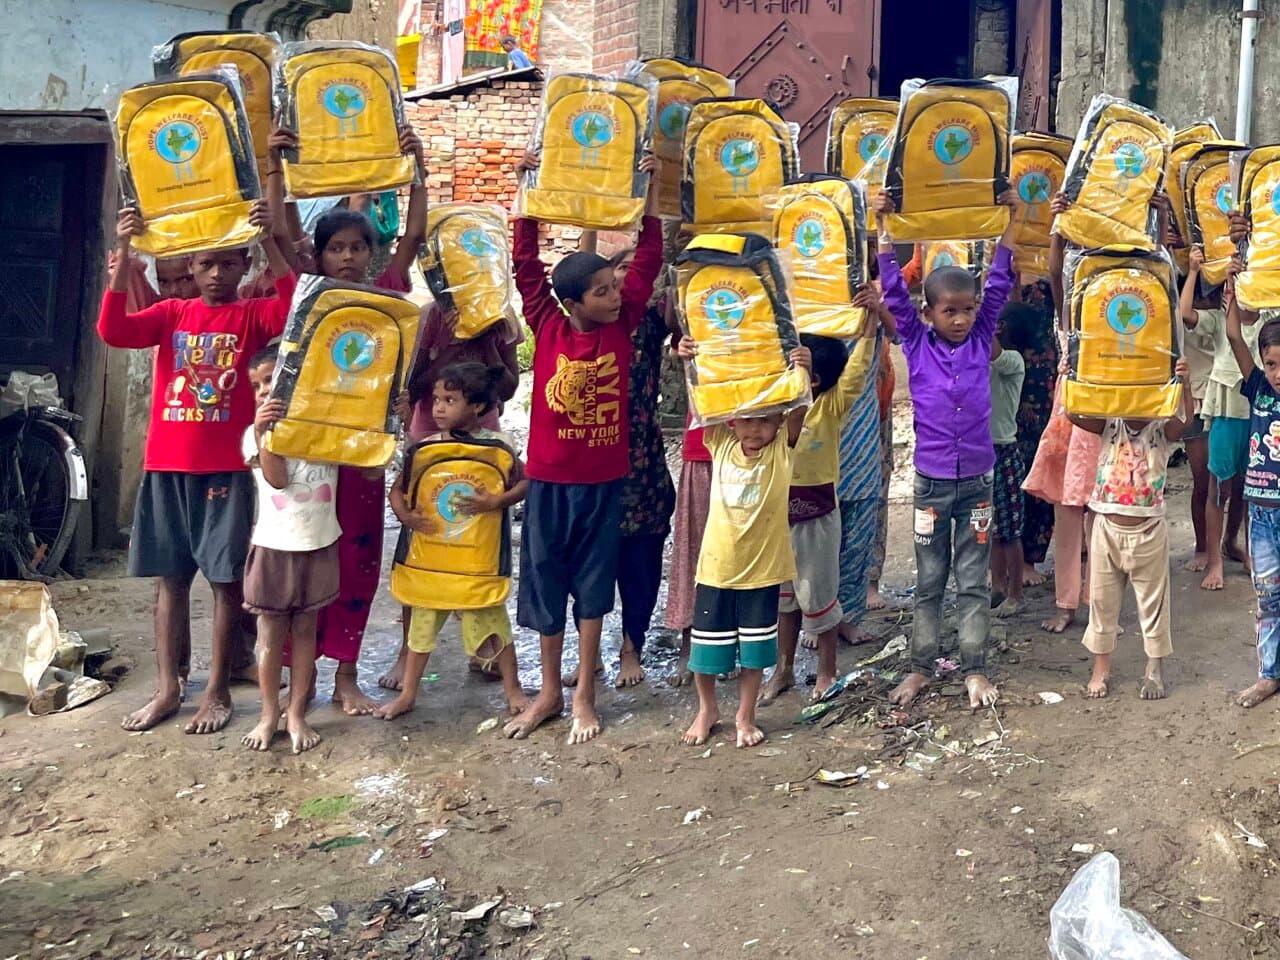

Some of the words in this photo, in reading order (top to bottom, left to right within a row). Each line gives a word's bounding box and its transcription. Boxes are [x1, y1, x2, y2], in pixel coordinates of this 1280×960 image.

[148, 127, 158, 151] HOPE
[157, 111, 193, 127] WELFARE
[194, 116, 209, 141] TRUST
[927, 128, 937, 151] HOPE
[936, 117, 971, 130] WELFARE
[971, 124, 981, 146] TRUST
[1099, 297, 1109, 318] HOPE
[1109, 286, 1144, 300] WELFARE
[1143, 292, 1156, 318] TRUST
[586, 360, 598, 426] BROOKLYN
[596, 352, 621, 426] NYC
[558, 427, 587, 440] NEW
[591, 426, 620, 439] YORK
[588, 436, 621, 448] STYLE
